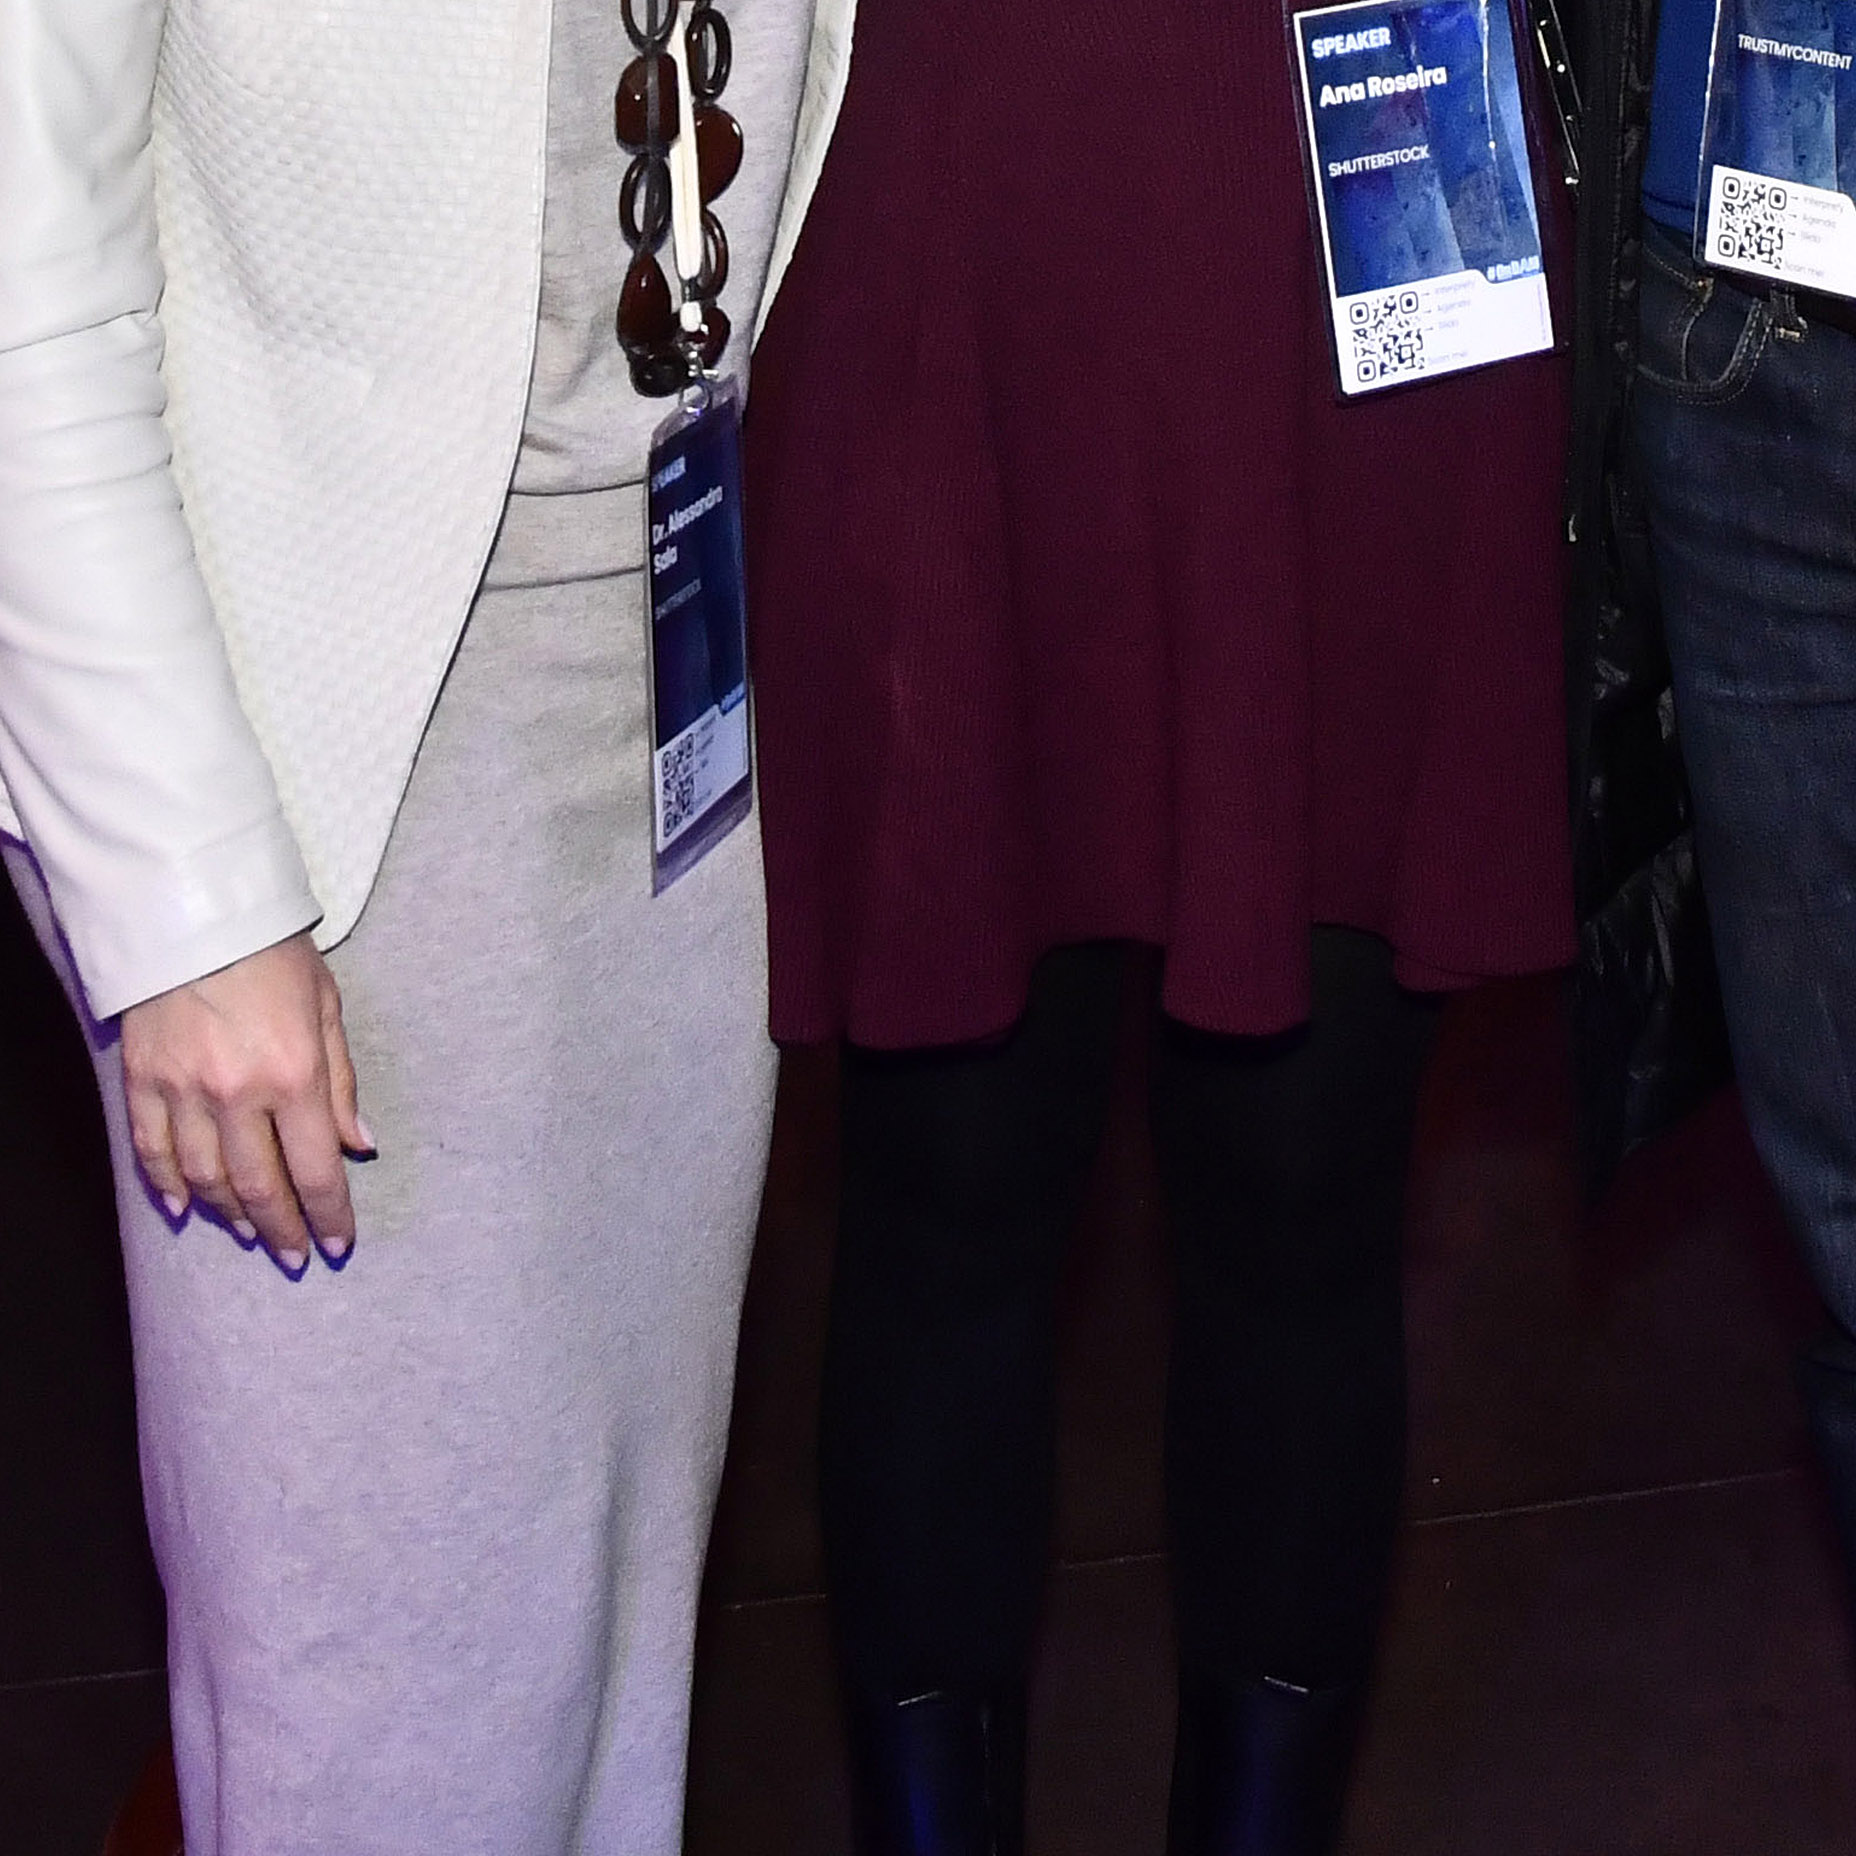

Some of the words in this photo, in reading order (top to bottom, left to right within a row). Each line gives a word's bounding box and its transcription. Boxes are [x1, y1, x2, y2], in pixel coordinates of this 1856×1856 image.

[1311, 25, 1391, 59] SPEAKER
[1738, 33, 1853, 70] TRUSTMYCONTENT
[1319, 80, 1366, 108] Ana
[1367, 63, 1448, 100] Roseira
[1328, 143, 1430, 177] SHUTTERSTOCK
